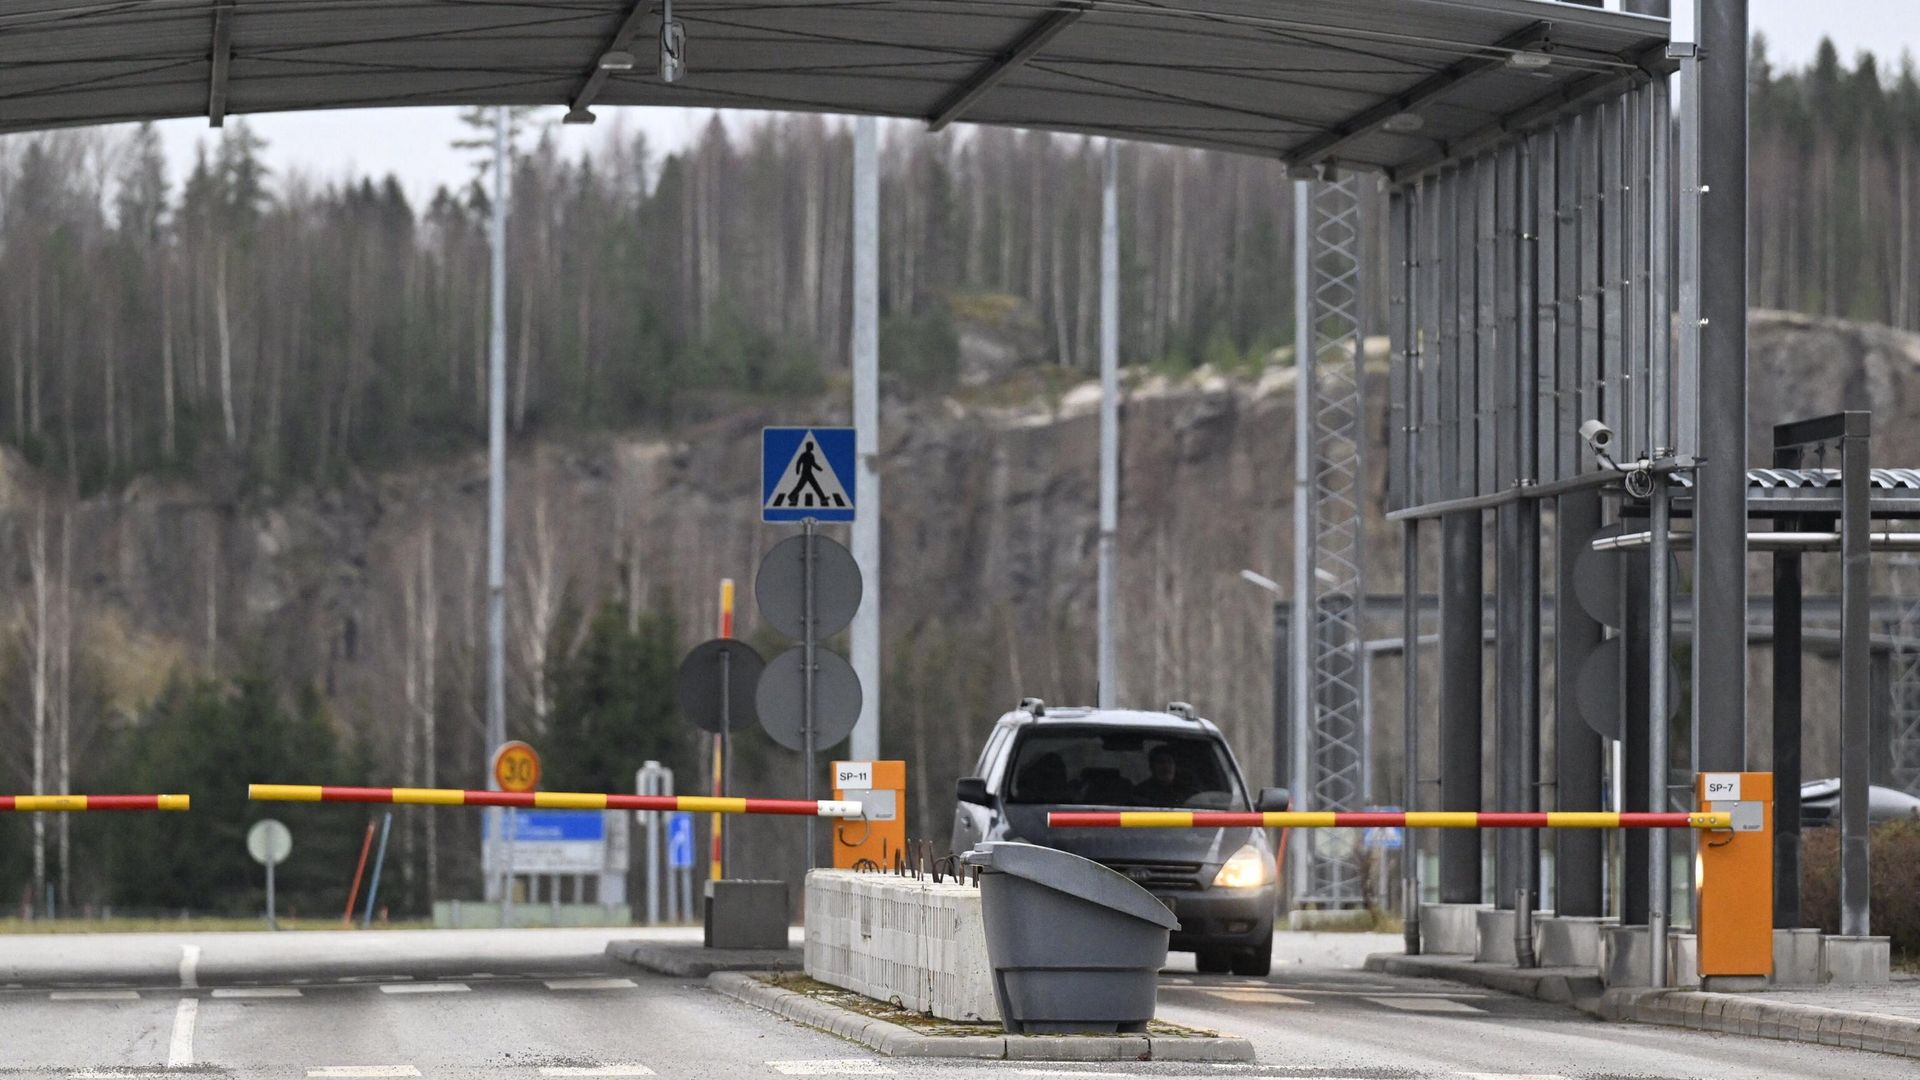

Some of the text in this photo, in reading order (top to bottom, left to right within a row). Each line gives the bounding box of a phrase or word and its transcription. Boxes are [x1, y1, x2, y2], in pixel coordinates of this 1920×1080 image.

[504, 756, 530, 784] 30
[840, 772, 867, 781] SP-11
[1709, 783, 1733, 792] SP-7
